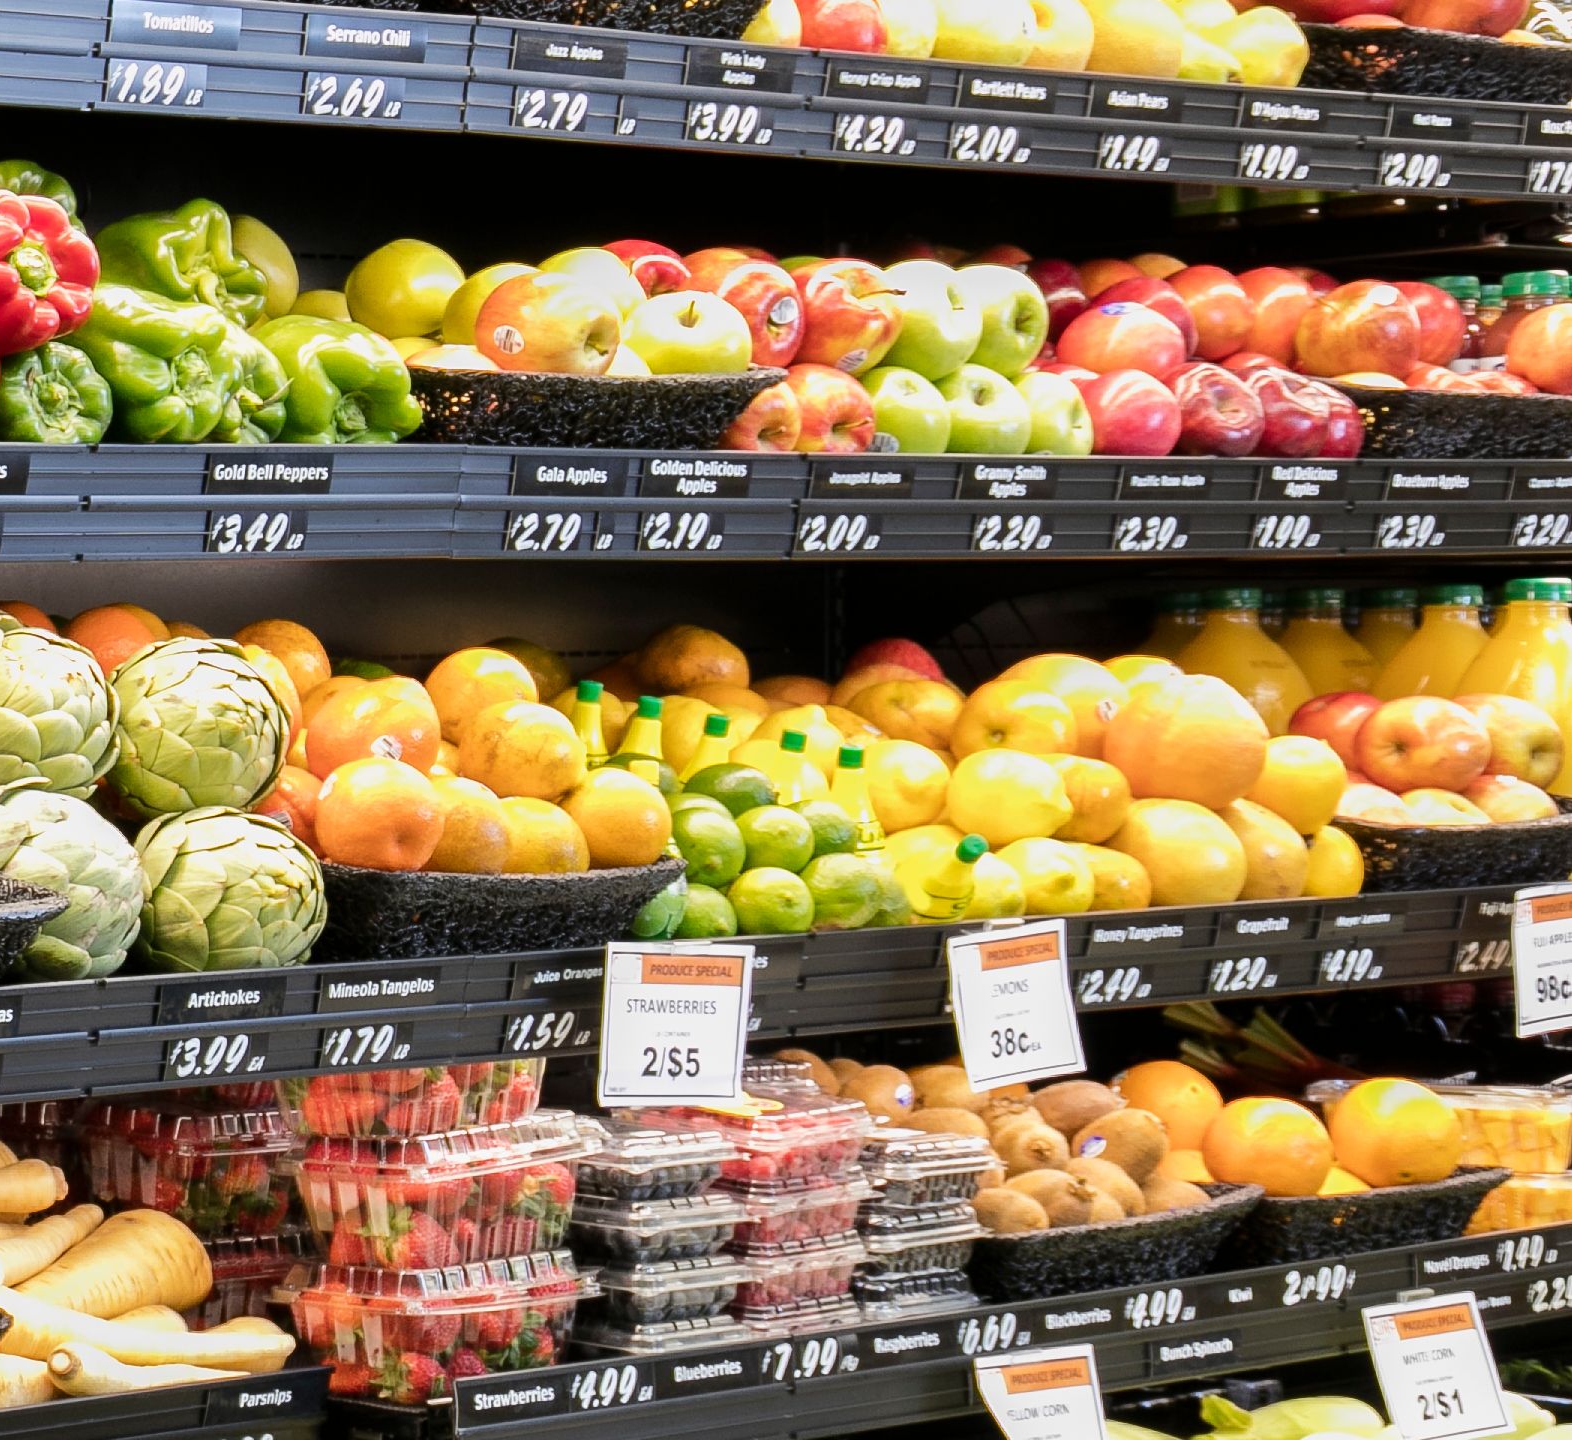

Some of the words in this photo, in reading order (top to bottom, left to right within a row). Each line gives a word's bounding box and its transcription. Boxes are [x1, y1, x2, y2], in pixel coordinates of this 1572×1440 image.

[143, 12, 214, 34] Tomatillos
[326, 25, 380, 45] Serrano
[383, 29, 410, 47] Chili
[546, 43, 567, 59] Jazz
[570, 45, 603, 62] Apples
[723, 69, 755, 86] Apples
[971, 79, 1015, 98] Bartlett
[1016, 82, 1047, 100] Pears
[1101, 134, 1159, 173] $1.49
[1242, 143, 1296, 180] $1.99
[214, 463, 244, 480] Gold
[247, 464, 273, 481] Bell
[275, 464, 328, 483] Peppers
[537, 467, 563, 482] Gala
[565, 467, 607, 485] Apples
[677, 477, 717, 495] Apples
[976, 515, 1041, 551] $2.29
[1116, 515, 1178, 551] $2.39
[534, 970, 561, 985] Juice
[564, 967, 603, 984] Oranges
[1212, 958, 1266, 991] $1.29
[188, 988, 260, 1009] Artichokes
[329, 980, 376, 1001] Mineola
[379, 976, 434, 998] Tangelos
[1046, 1306, 1111, 1330] Blackberries
[1125, 1288, 1183, 1330] $4.99
[874, 1331, 940, 1354] Raspberries
[959, 1314, 1017, 1355] $6.69
[762, 1338, 837, 1380] $7.99
